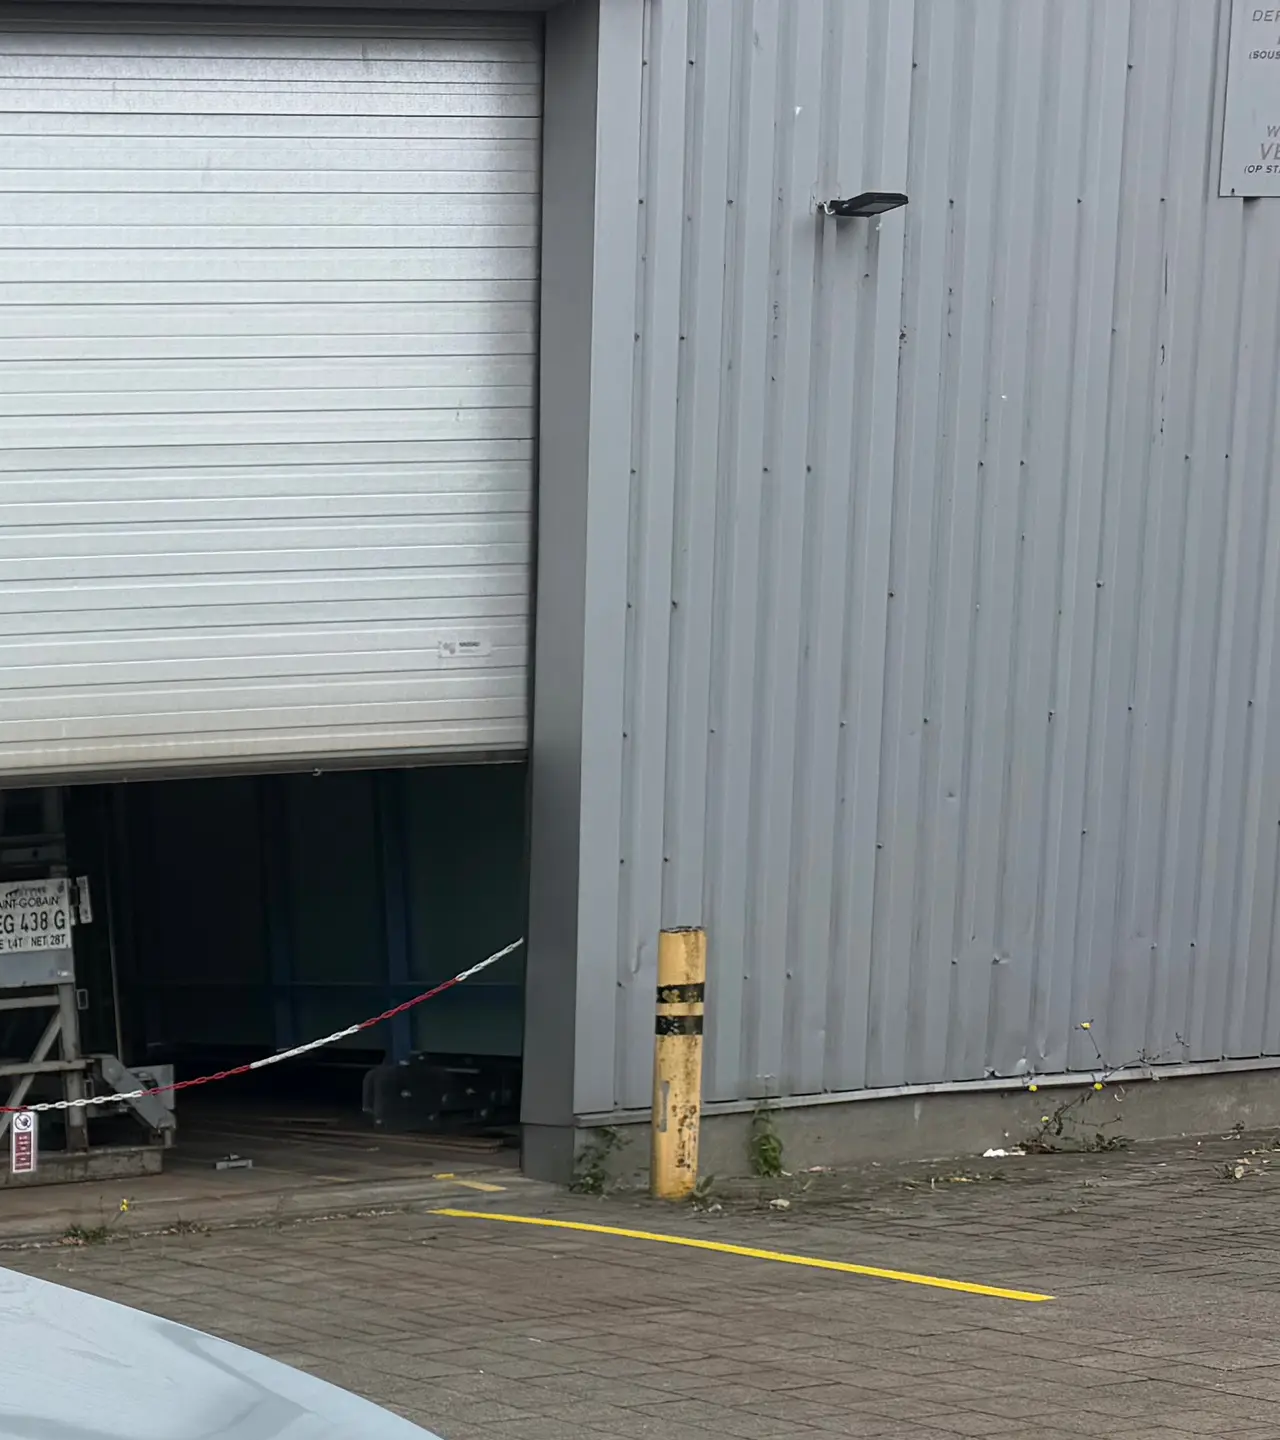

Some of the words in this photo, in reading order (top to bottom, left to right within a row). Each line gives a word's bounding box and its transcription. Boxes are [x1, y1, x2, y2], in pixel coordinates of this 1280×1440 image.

[1244, 164, 1263, 174] (OP
[1266, 164, 1280, 174] ST
[20, 910, 49, 933] 438
[53, 908, 66, 931] G
[31, 935, 47, 947] NET
